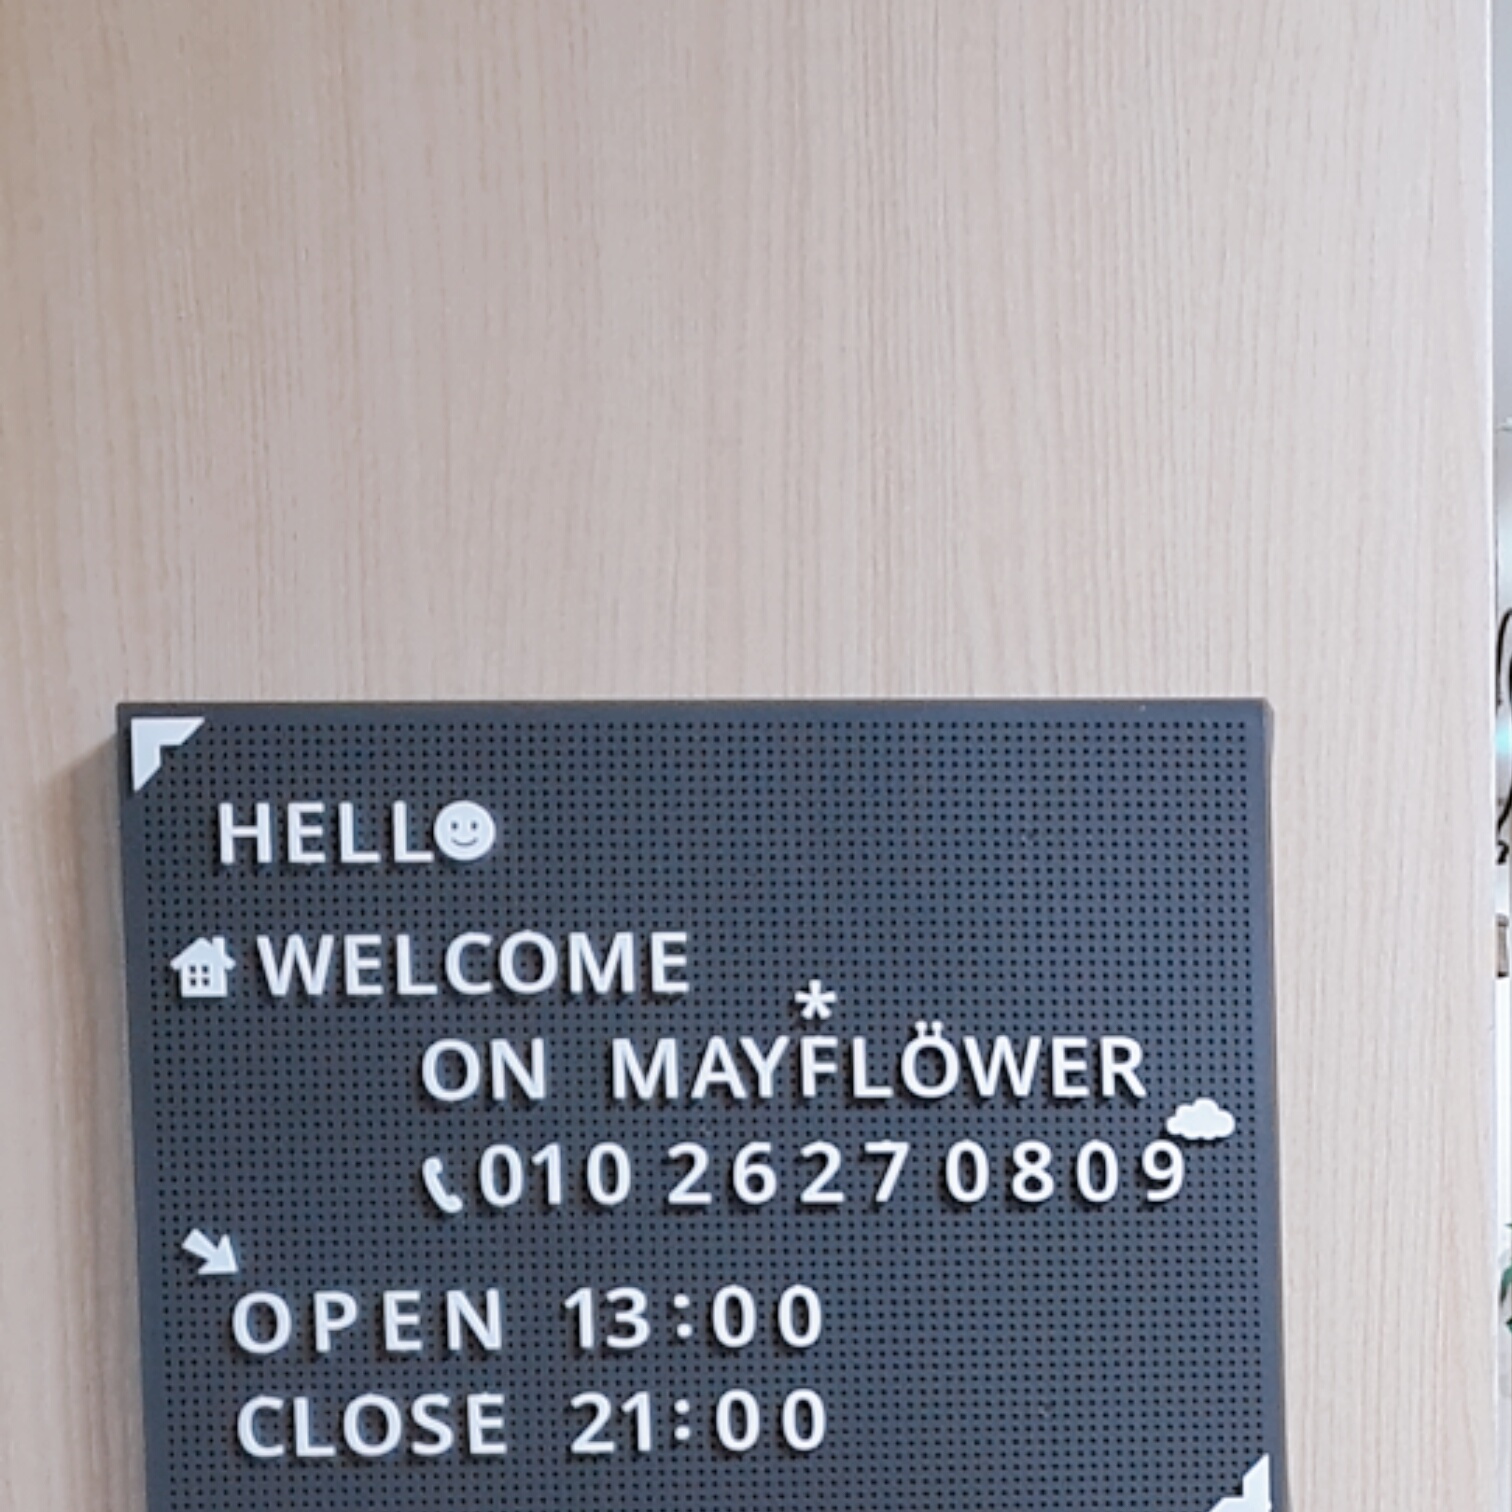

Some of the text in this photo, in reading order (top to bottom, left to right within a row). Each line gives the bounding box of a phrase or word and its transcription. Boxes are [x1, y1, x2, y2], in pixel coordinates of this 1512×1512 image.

[255, 929, 691, 997] WELCOME
[421, 1036, 547, 1102] ON
[479, 1138, 1186, 1207] 010 2627 0809
[232, 1284, 823, 1355] OPEN 13:00
[237, 1388, 827, 1458] CLOSE 21:00
